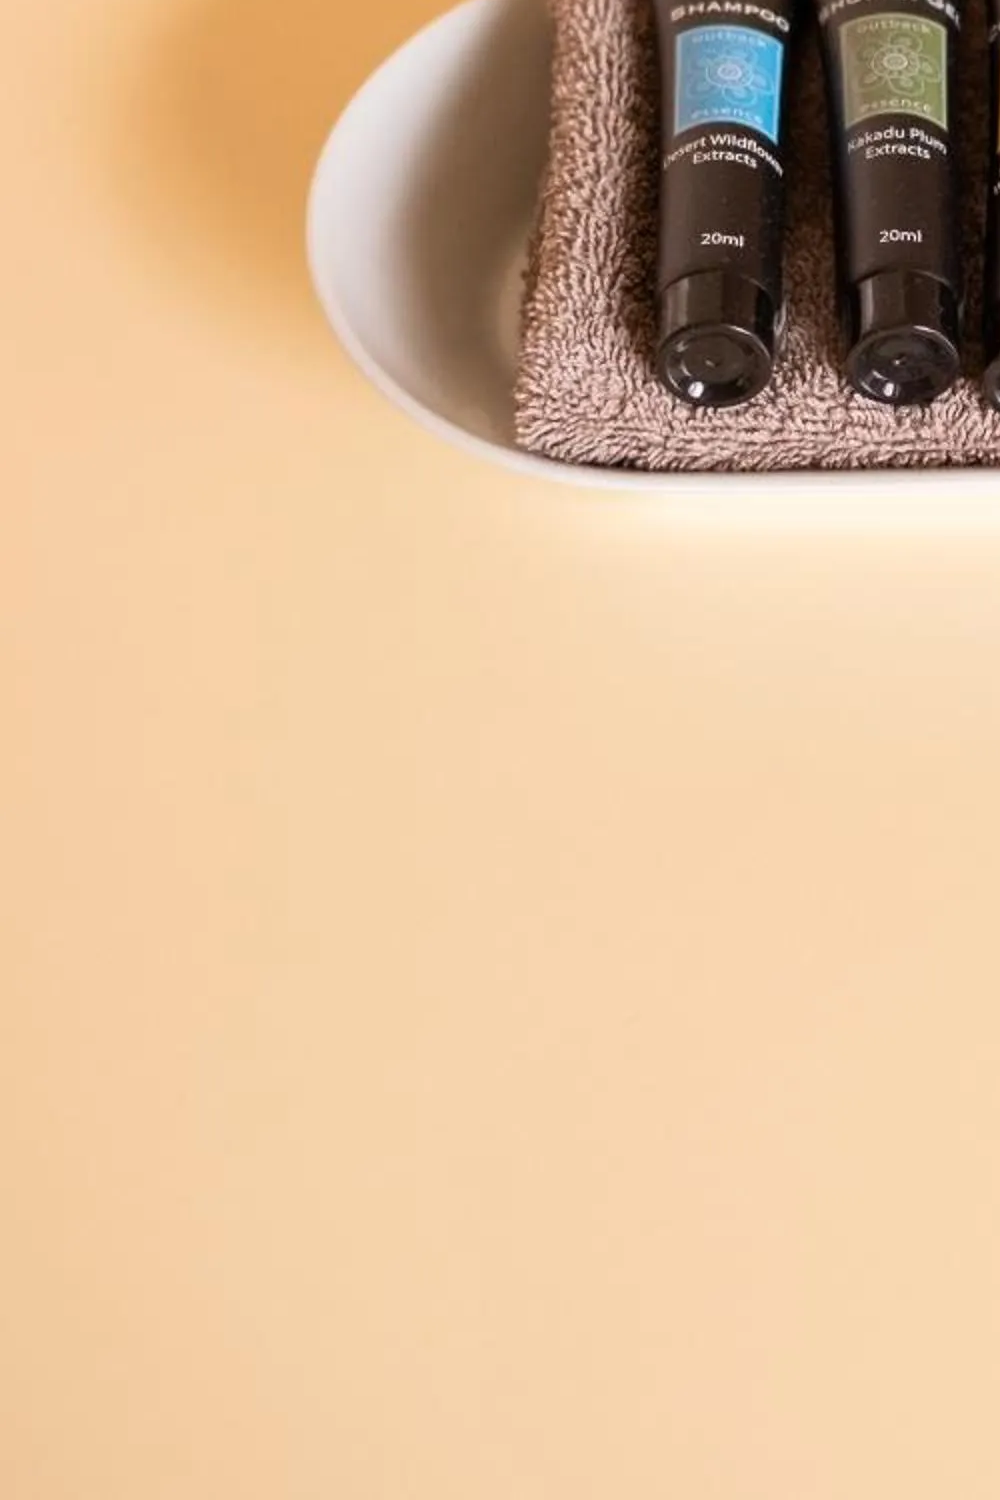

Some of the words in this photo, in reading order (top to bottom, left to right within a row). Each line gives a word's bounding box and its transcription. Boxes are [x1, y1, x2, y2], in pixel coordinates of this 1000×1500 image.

[671, 1, 790, 33] SHAMPOO
[857, 20, 933, 34] outback
[860, 99, 932, 113] essence
[909, 127, 947, 155] Plum
[864, 143, 932, 159] Extracts
[693, 151, 758, 169] Extracts
[701, 231, 744, 248] 20ml
[879, 228, 922, 243] 20ml
